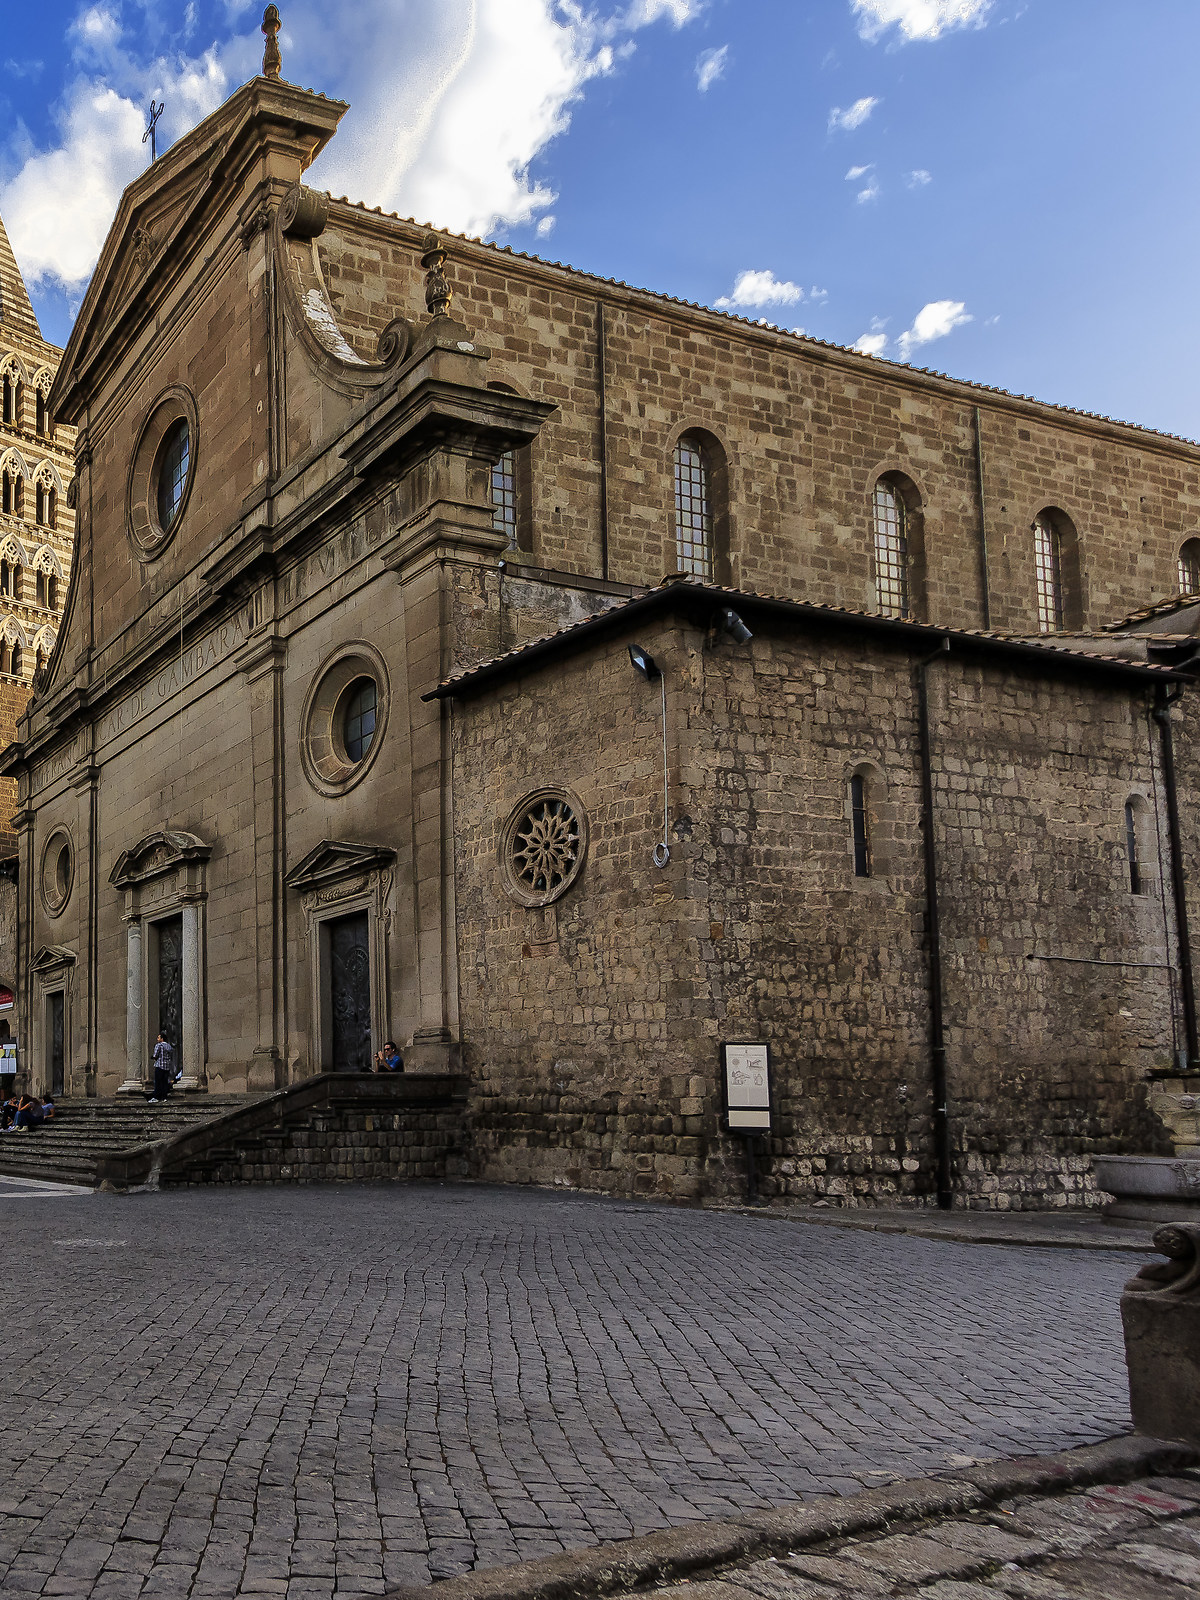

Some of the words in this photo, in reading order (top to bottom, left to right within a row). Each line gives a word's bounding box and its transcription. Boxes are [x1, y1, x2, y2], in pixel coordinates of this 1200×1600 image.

[97, 706, 125, 741] CAR
[131, 688, 148, 720] DE
[156, 616, 246, 698] GAMBARA
